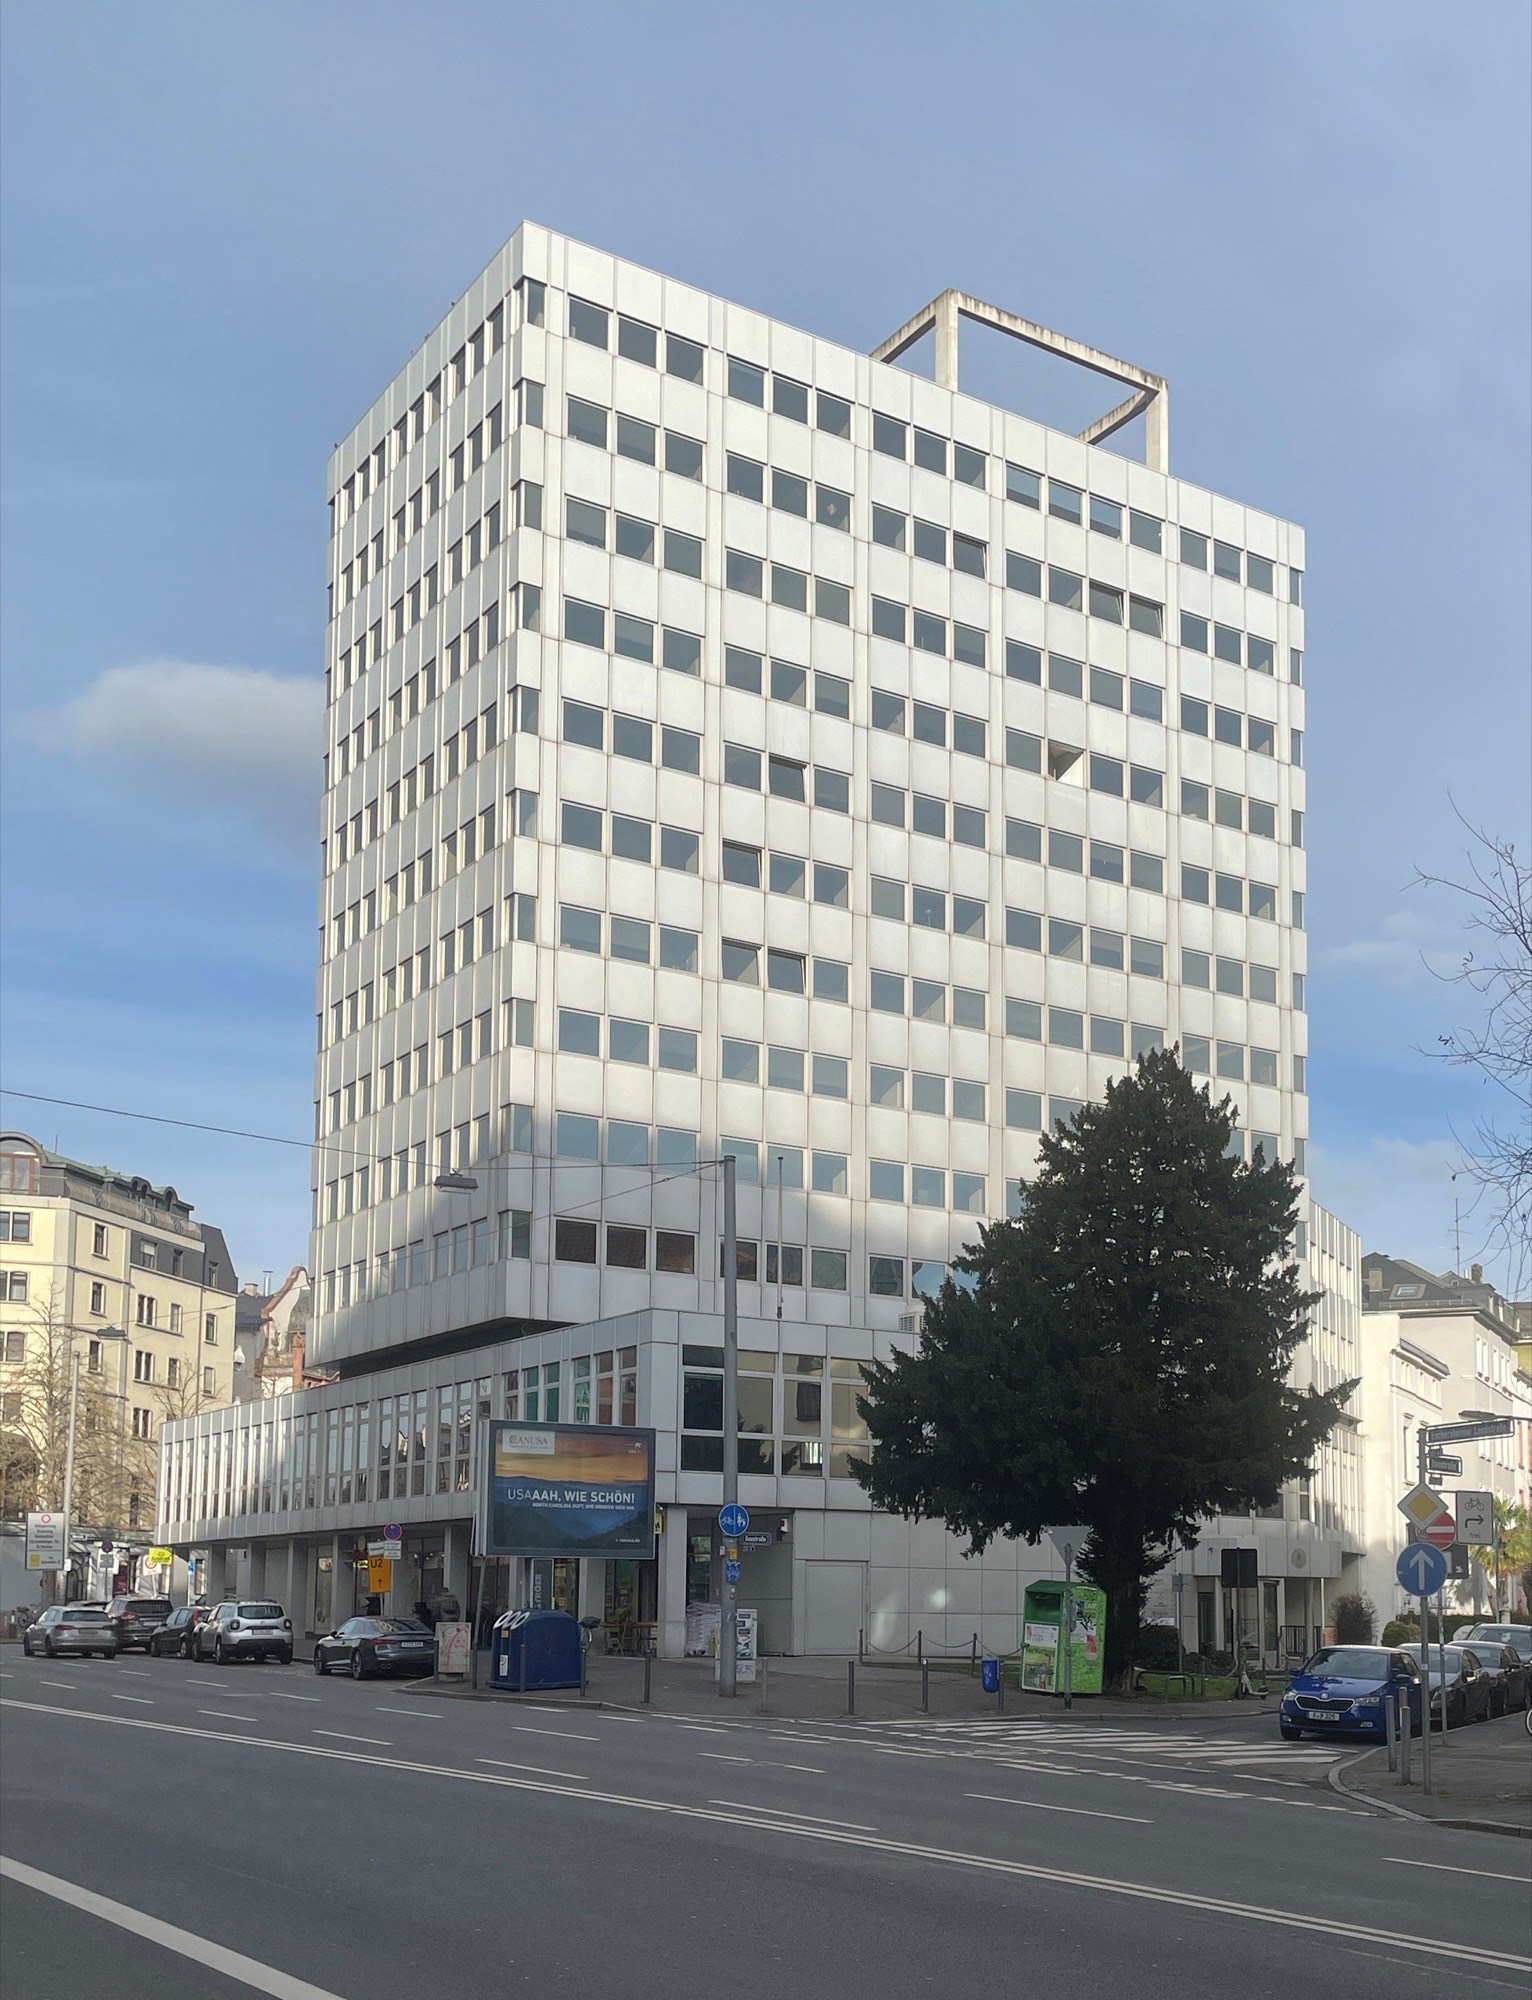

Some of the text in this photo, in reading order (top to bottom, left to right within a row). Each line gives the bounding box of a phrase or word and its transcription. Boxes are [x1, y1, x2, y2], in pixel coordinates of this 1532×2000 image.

[509, 1434, 548, 1446] CANUSA
[507, 1488, 635, 1504] USAAAH, WIE SCHÖN!
[370, 1558, 383, 1568] U2
